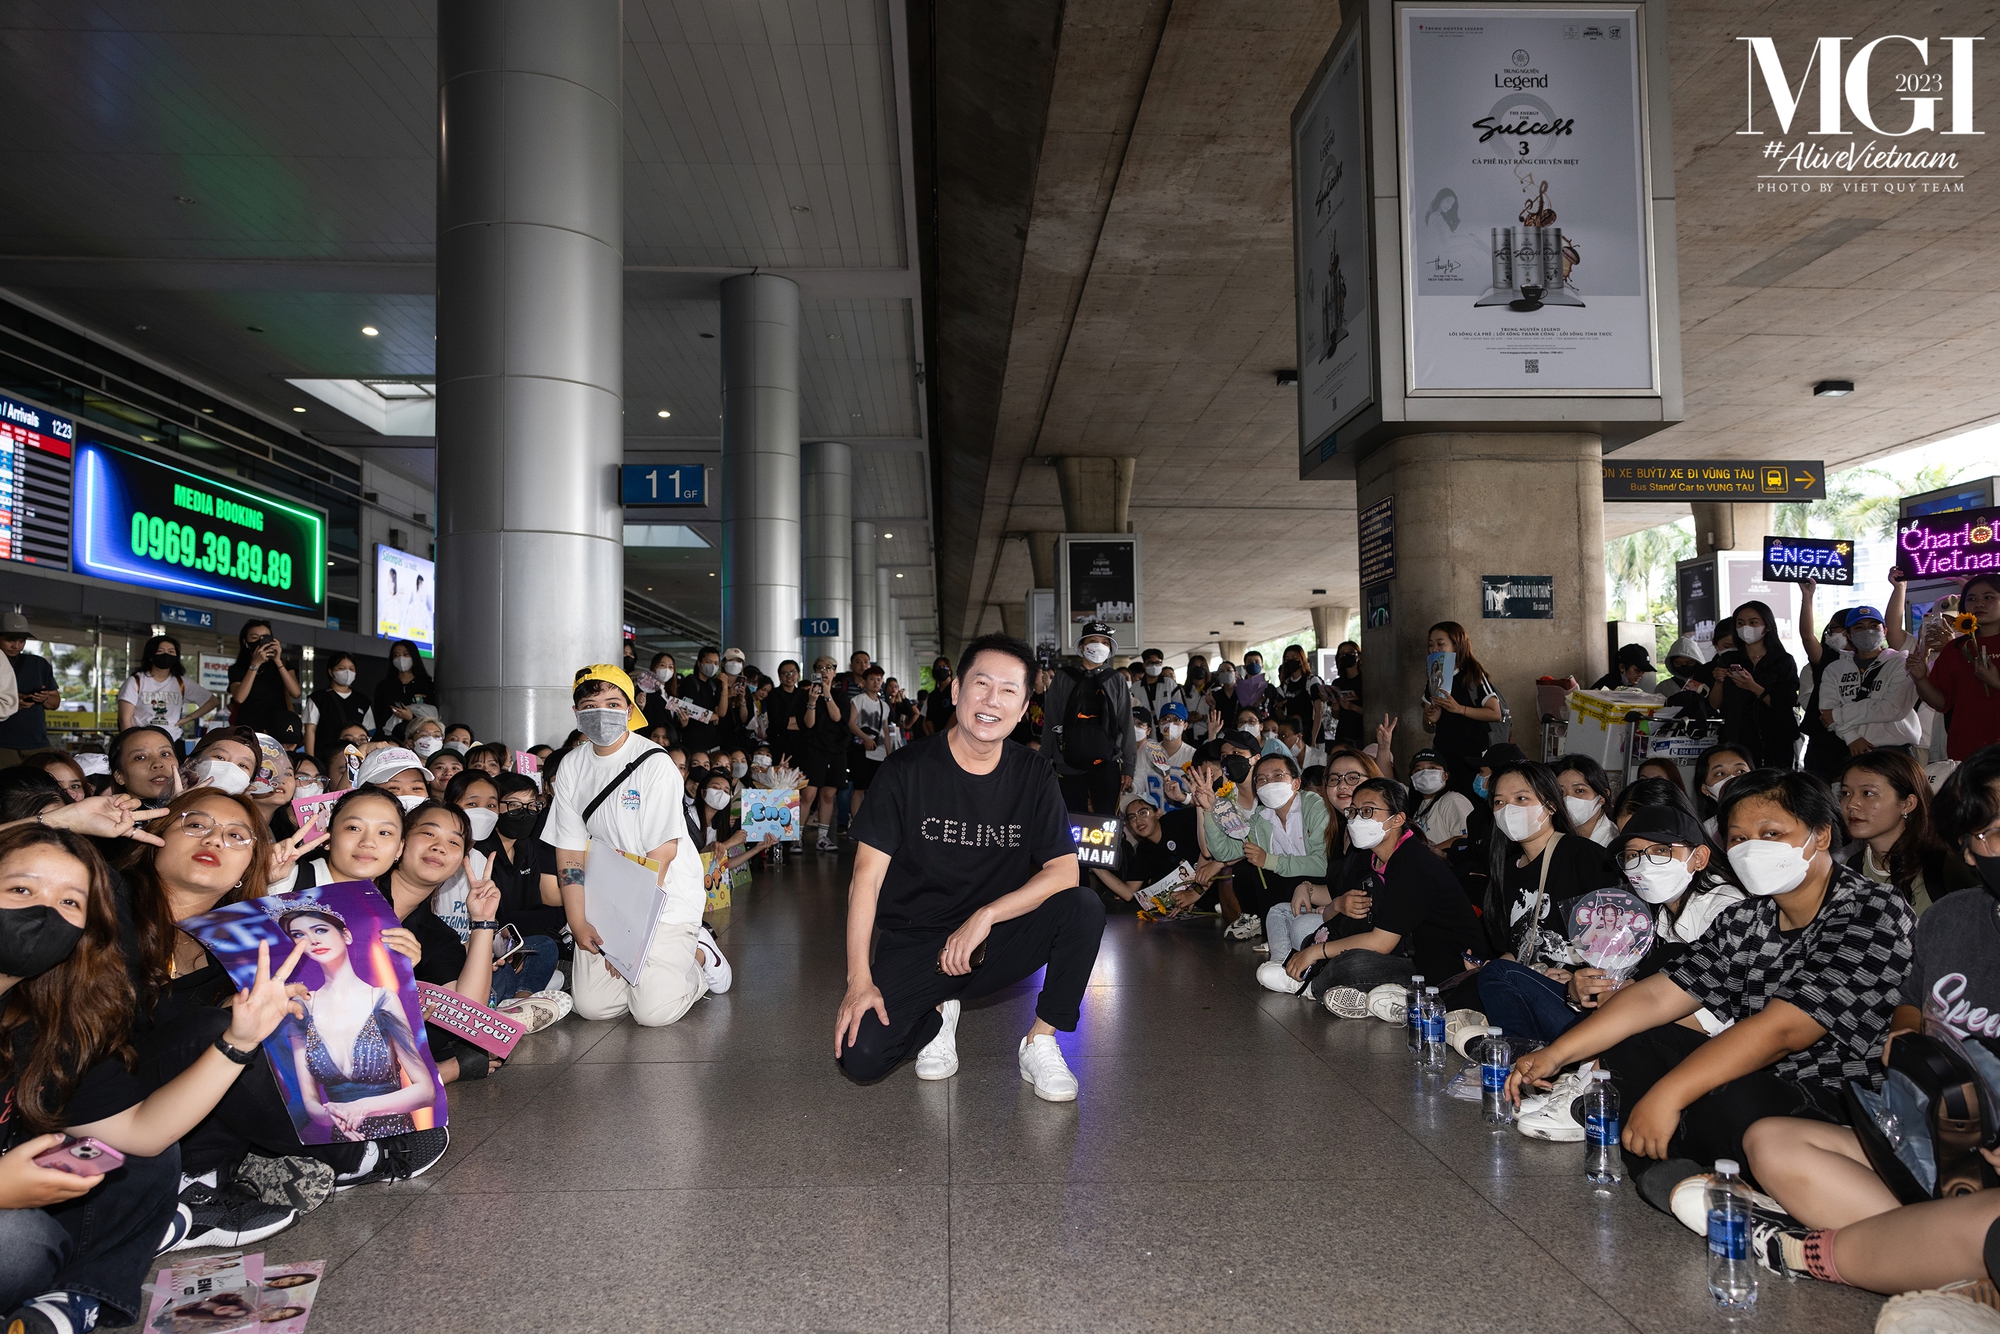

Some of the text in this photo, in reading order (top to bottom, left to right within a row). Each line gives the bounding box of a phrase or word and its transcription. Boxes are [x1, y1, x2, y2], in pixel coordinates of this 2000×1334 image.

[1494, 73, 1548, 91] Legend
[1472, 116, 1575, 143] Success
[1518, 141, 1530, 156] 3
[7, 403, 40, 428] Arrivals
[645, 469, 698, 499] 11 GF
[1619, 468, 1633, 478] XE
[1636, 465, 1667, 479] BUÝT/
[1669, 468, 1684, 479] XE
[1687, 468, 1698, 479] ĐI
[1701, 466, 1731, 479] VŨNG
[1734, 466, 1755, 479] TÀU
[1630, 482, 1647, 491] Bus
[1649, 482, 1677, 491] Stand/
[1678, 483, 1695, 491] Car
[1706, 483, 1734, 492] VUNG
[1735, 483, 1755, 492] TAU
[174, 483, 264, 532] MEDIA BOOKING
[131, 511, 292, 590] 0969.39.89.89
[1770, 547, 1842, 566] ENGFA
[1770, 564, 1848, 581] VNFANS
[200, 613, 211, 626] A2
[811, 620, 830, 634] 10
[751, 803, 792, 827] Eng
[921, 816, 1022, 848] CELINE
[1071, 825, 1115, 847] GLOT
[424, 988, 517, 1035] SMILE WITH YOU
[1932, 972, 2000, 1040] Spee
[425, 997, 511, 1044] WITH YOU!
